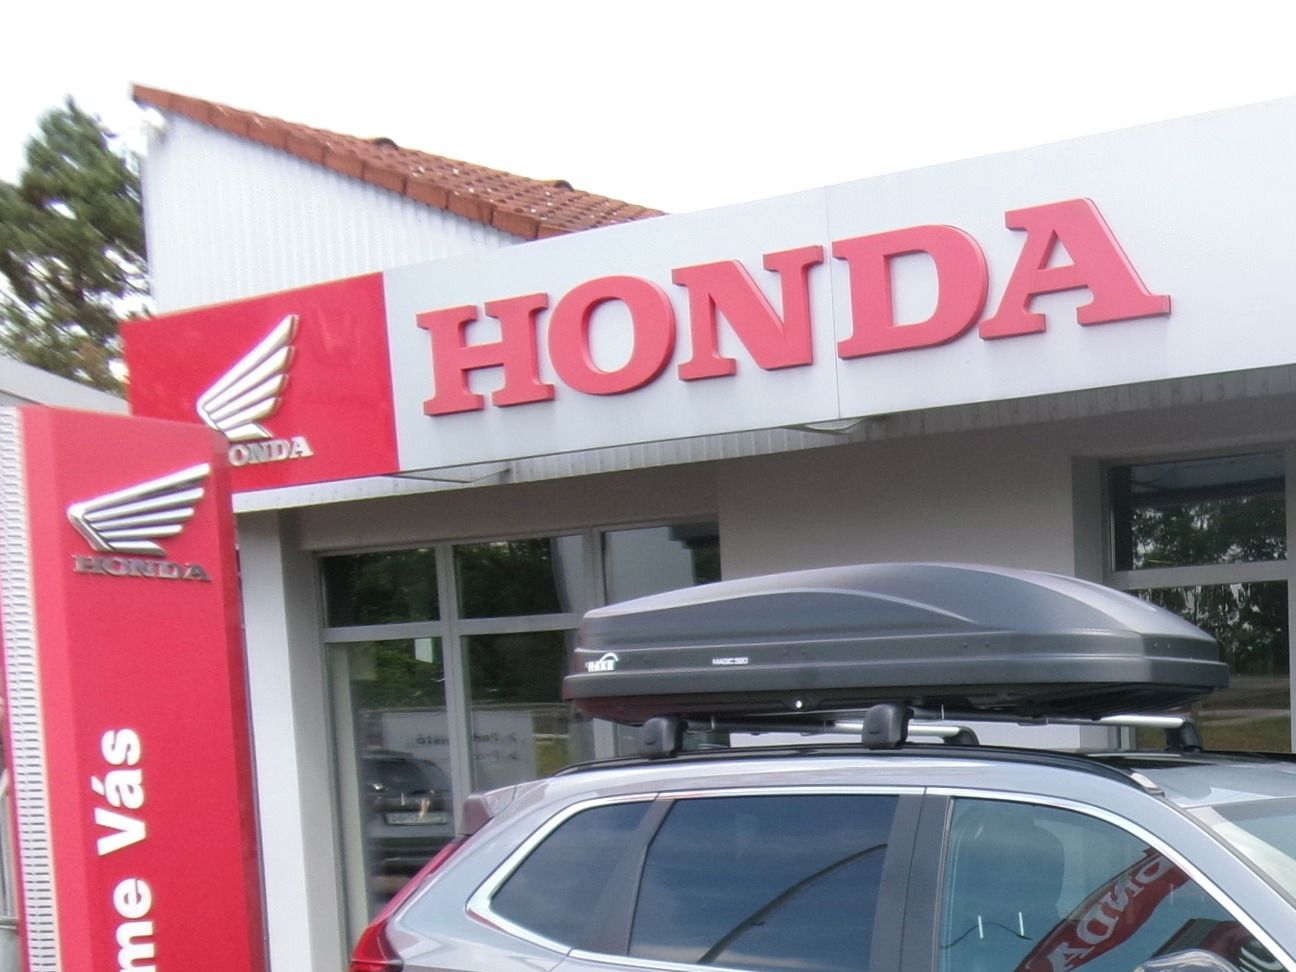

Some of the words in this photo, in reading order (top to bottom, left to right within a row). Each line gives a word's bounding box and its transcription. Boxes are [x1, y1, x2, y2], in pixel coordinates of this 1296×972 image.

[416, 198, 1171, 416] HONDA
[228, 436, 315, 467] ONDA
[73, 555, 212, 582] HONDA
[91, 728, 147, 856] Vás
